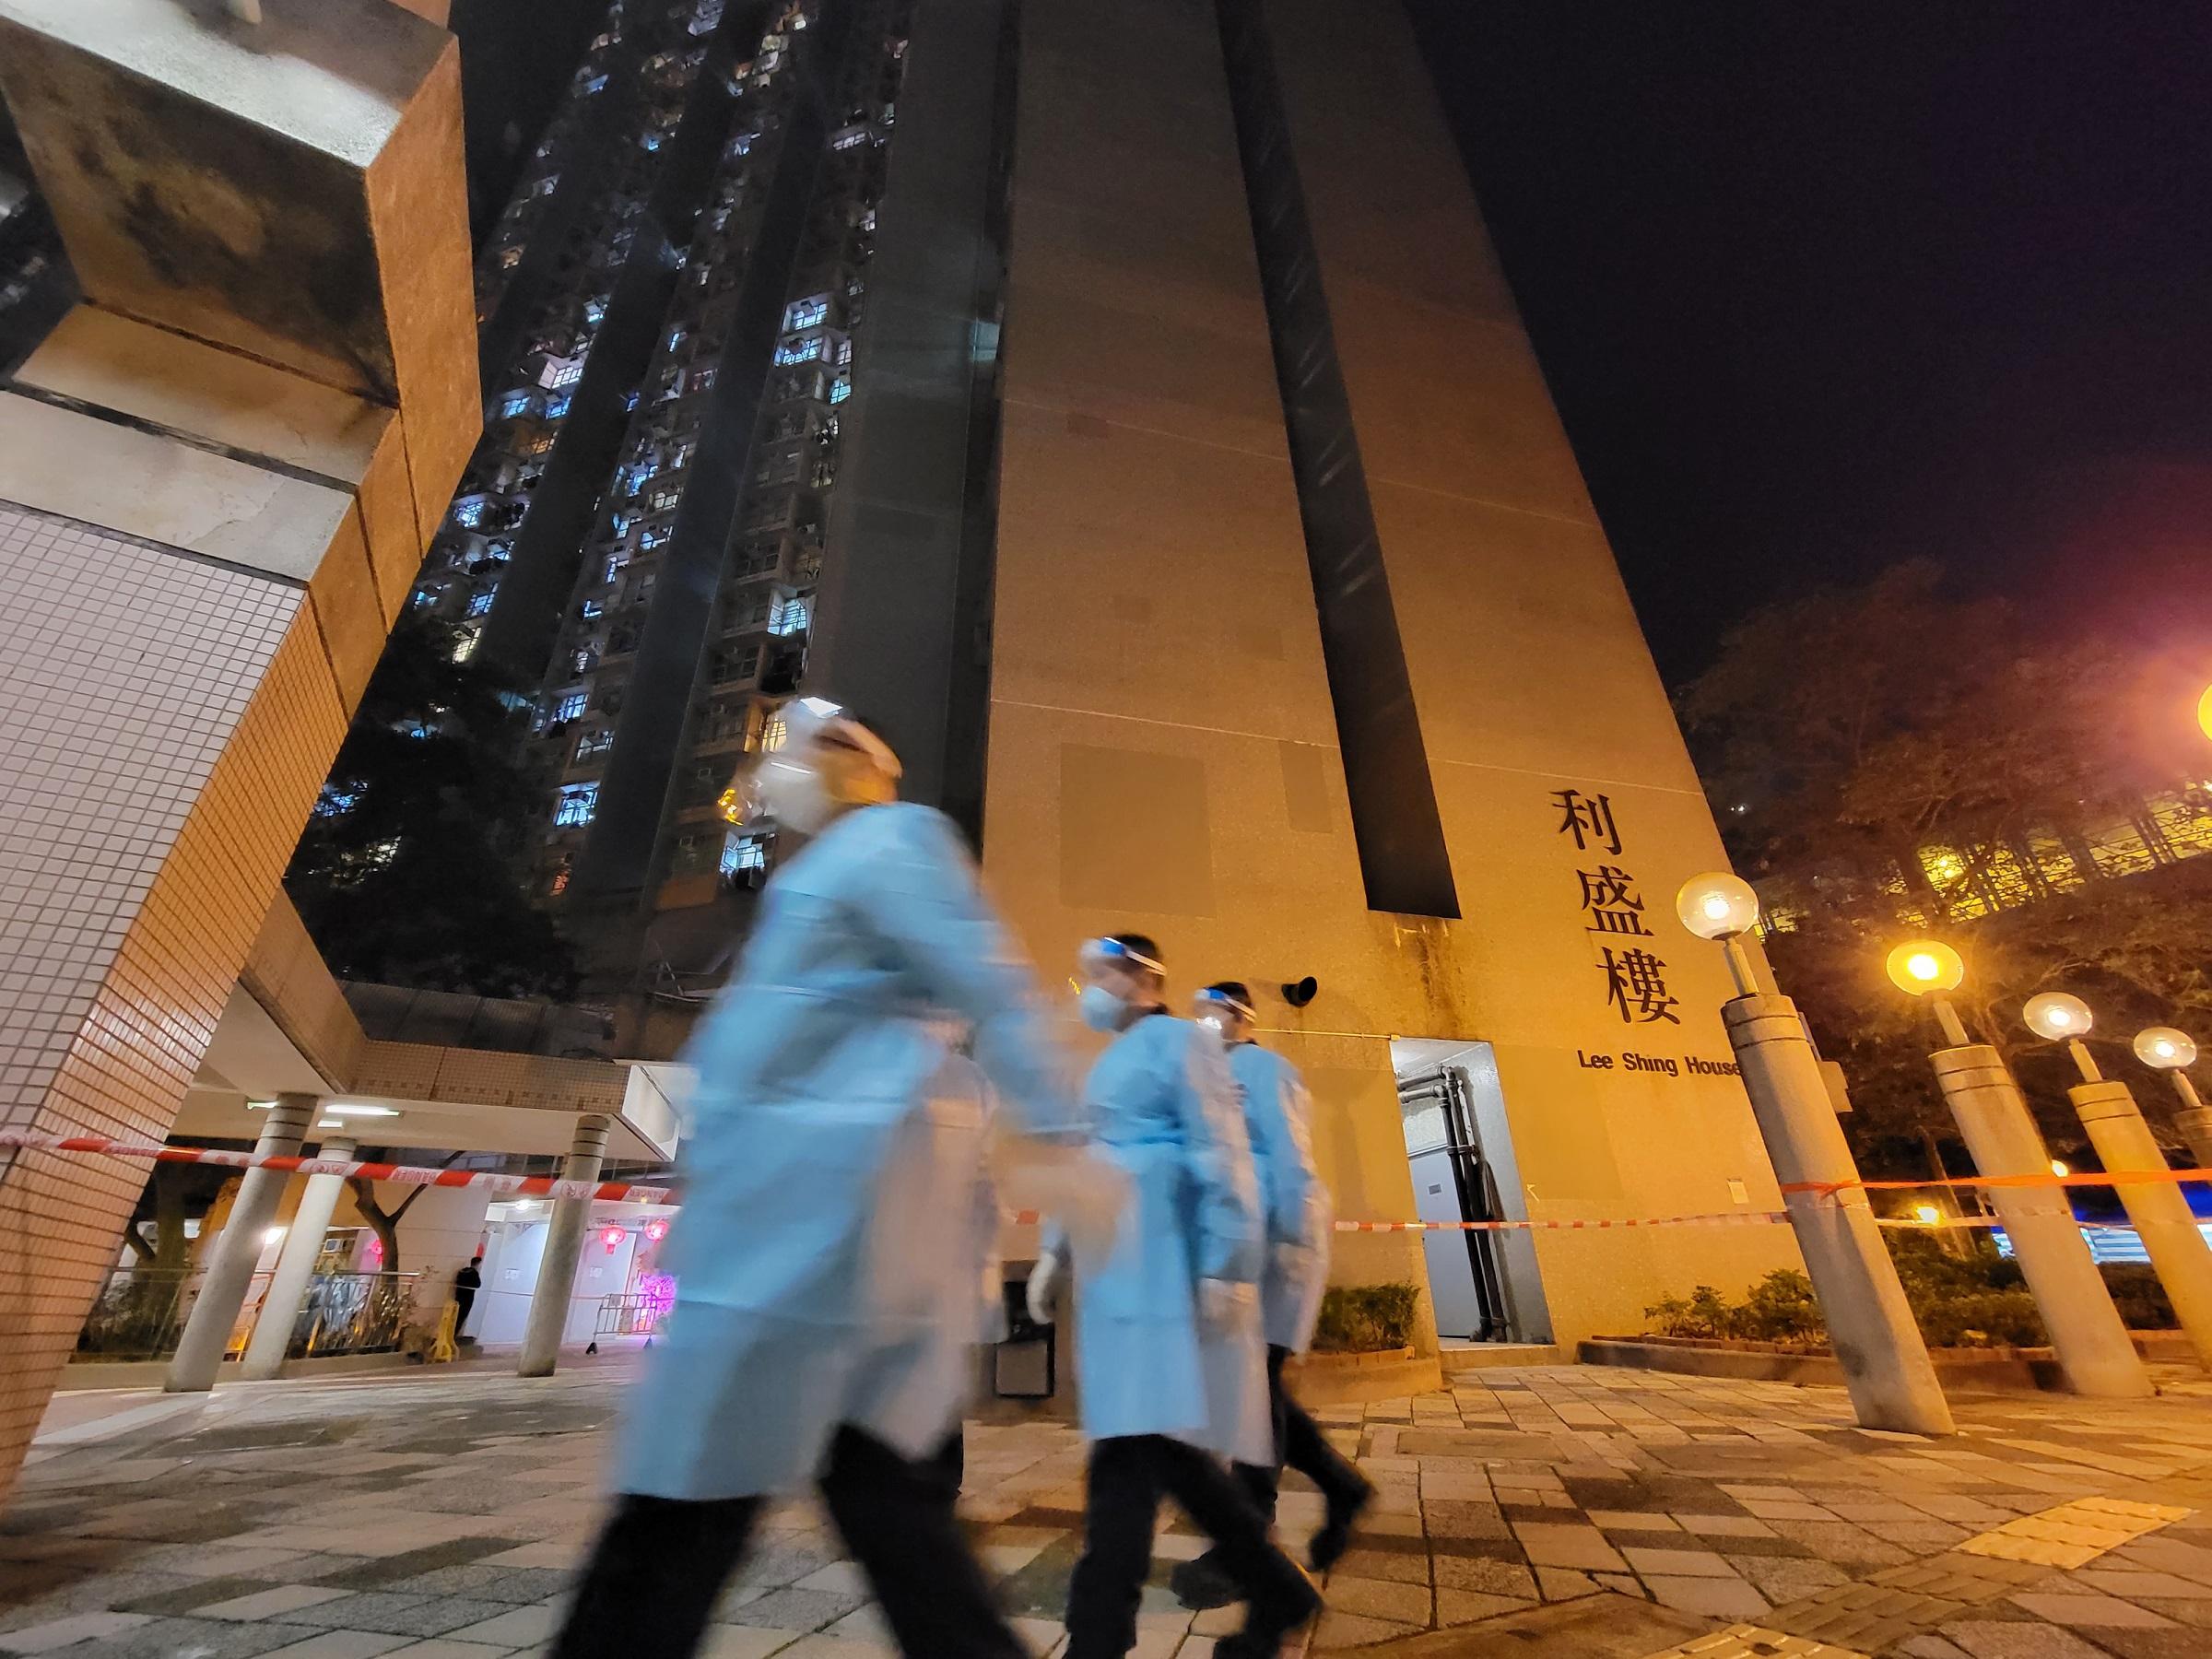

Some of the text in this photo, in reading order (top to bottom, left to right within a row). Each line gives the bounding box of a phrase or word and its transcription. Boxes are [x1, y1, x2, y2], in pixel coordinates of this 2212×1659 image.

[1548, 789, 1681, 1025] 利盛樓
[1577, 1049, 1742, 1077] Lee Shing House
